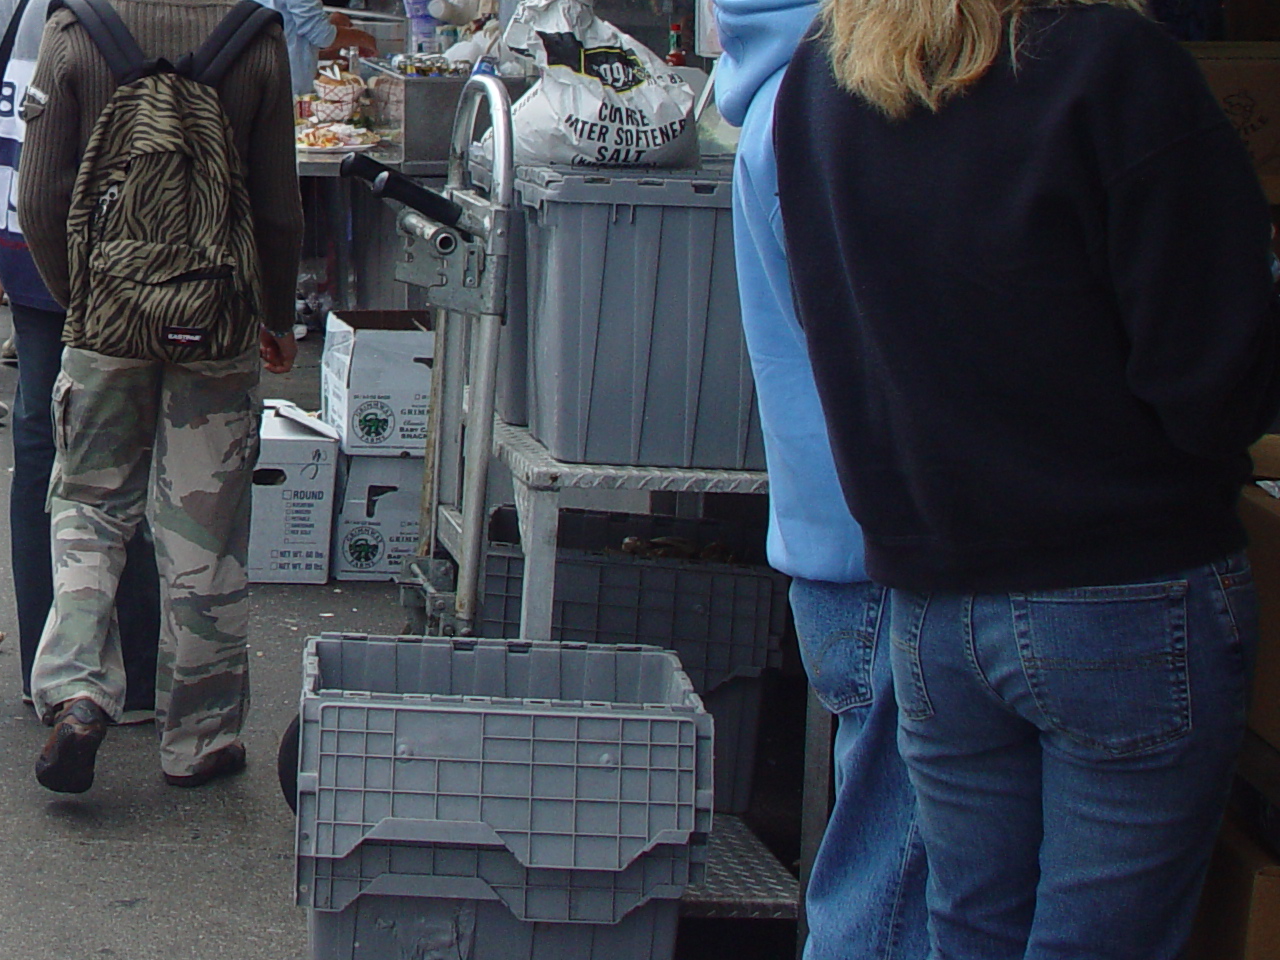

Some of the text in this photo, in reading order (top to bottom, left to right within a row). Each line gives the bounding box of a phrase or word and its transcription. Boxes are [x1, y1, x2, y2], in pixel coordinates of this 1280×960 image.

[614, 117, 687, 148] SOFTENER
[595, 145, 646, 163] SALT
[293, 490, 324, 501] ROUND
